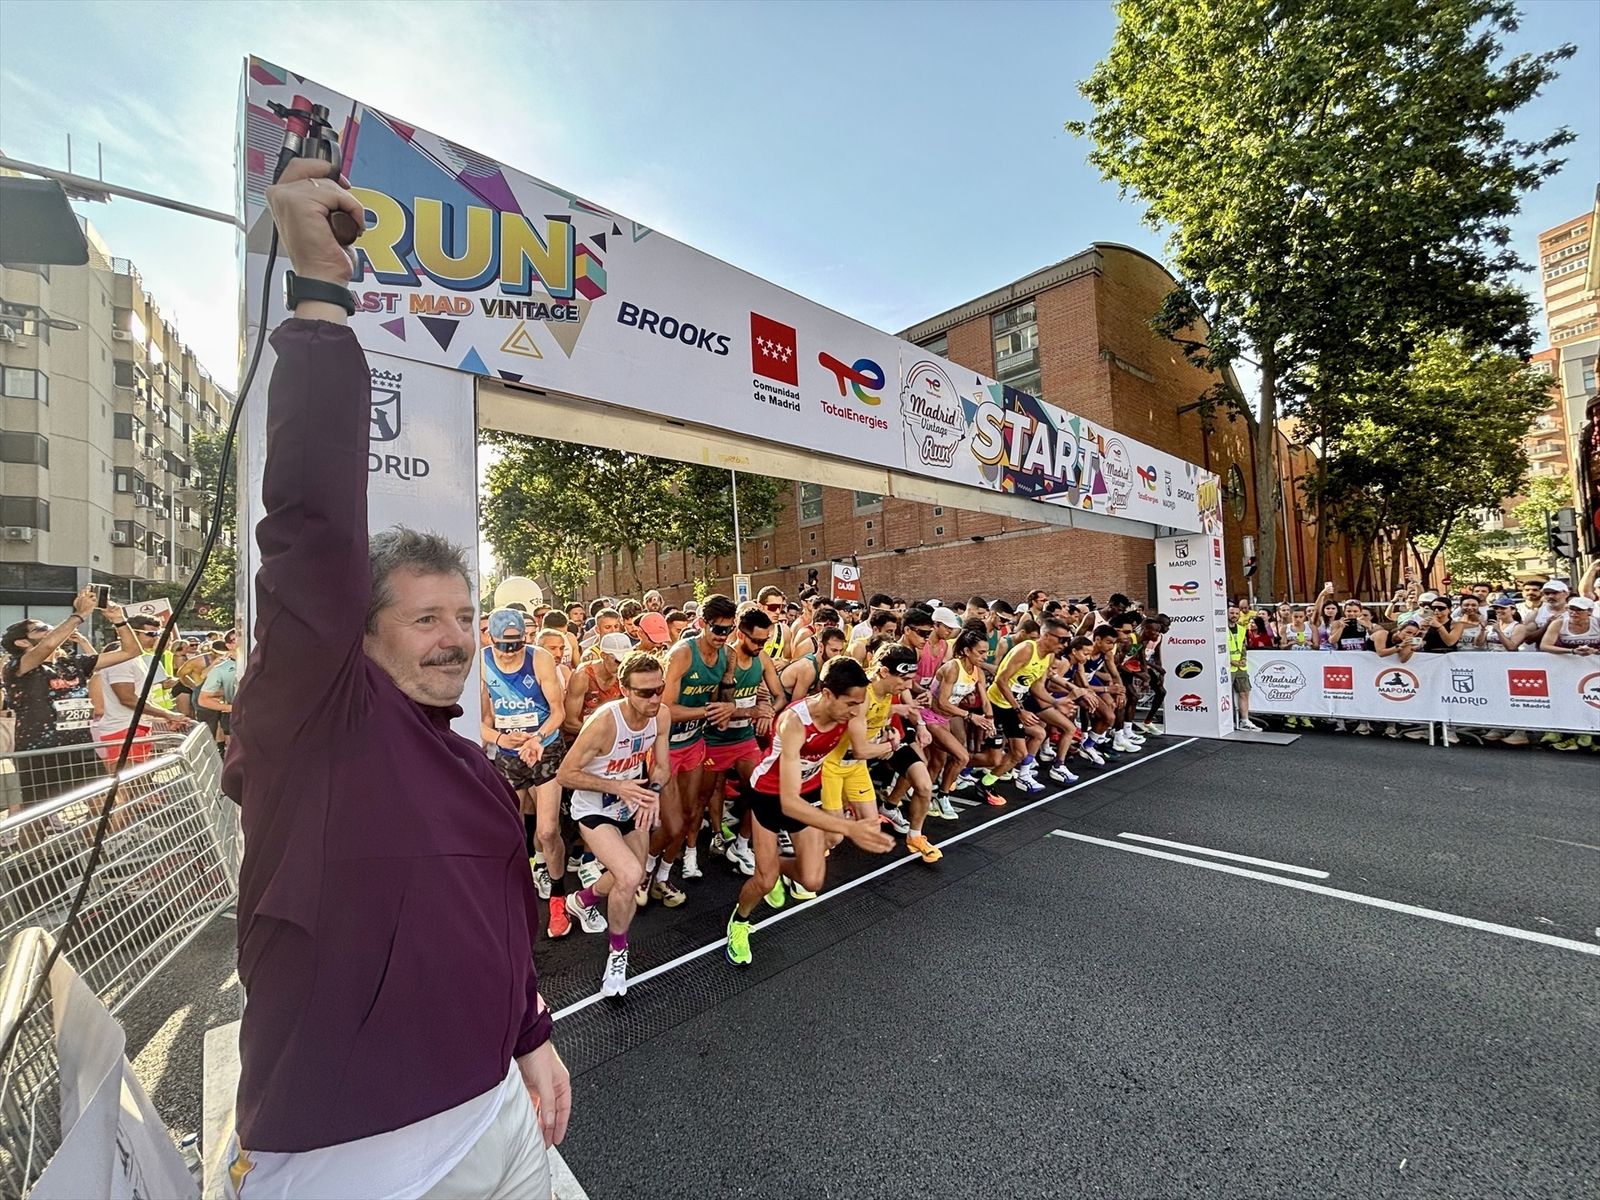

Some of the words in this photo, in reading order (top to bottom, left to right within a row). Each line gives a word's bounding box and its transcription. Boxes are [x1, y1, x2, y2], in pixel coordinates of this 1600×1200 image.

[350, 186, 576, 300] RUN
[350, 291, 402, 314] AST
[409, 293, 474, 316] MAD
[480, 298, 580, 323] VINTAGE
[617, 301, 731, 356] BROOKS
[753, 379, 800, 400] Comunidad
[754, 391, 766, 402] de
[769, 395, 801, 412] Madrid
[820, 400, 889, 430] TotalEnergies
[910, 393, 956, 426] Madrid
[922, 435, 956, 463] Run
[971, 401, 1099, 491] START
[369, 453, 430, 480] DRID
[1177, 488, 1195, 502] BROOKS
[1168, 637, 1206, 645] Alcampo
[1260, 674, 1298, 684] Madrid
[1174, 704, 1194, 712] KISS
[1441, 696, 1488, 706] MADRID
[66, 709, 91, 720] 2876
